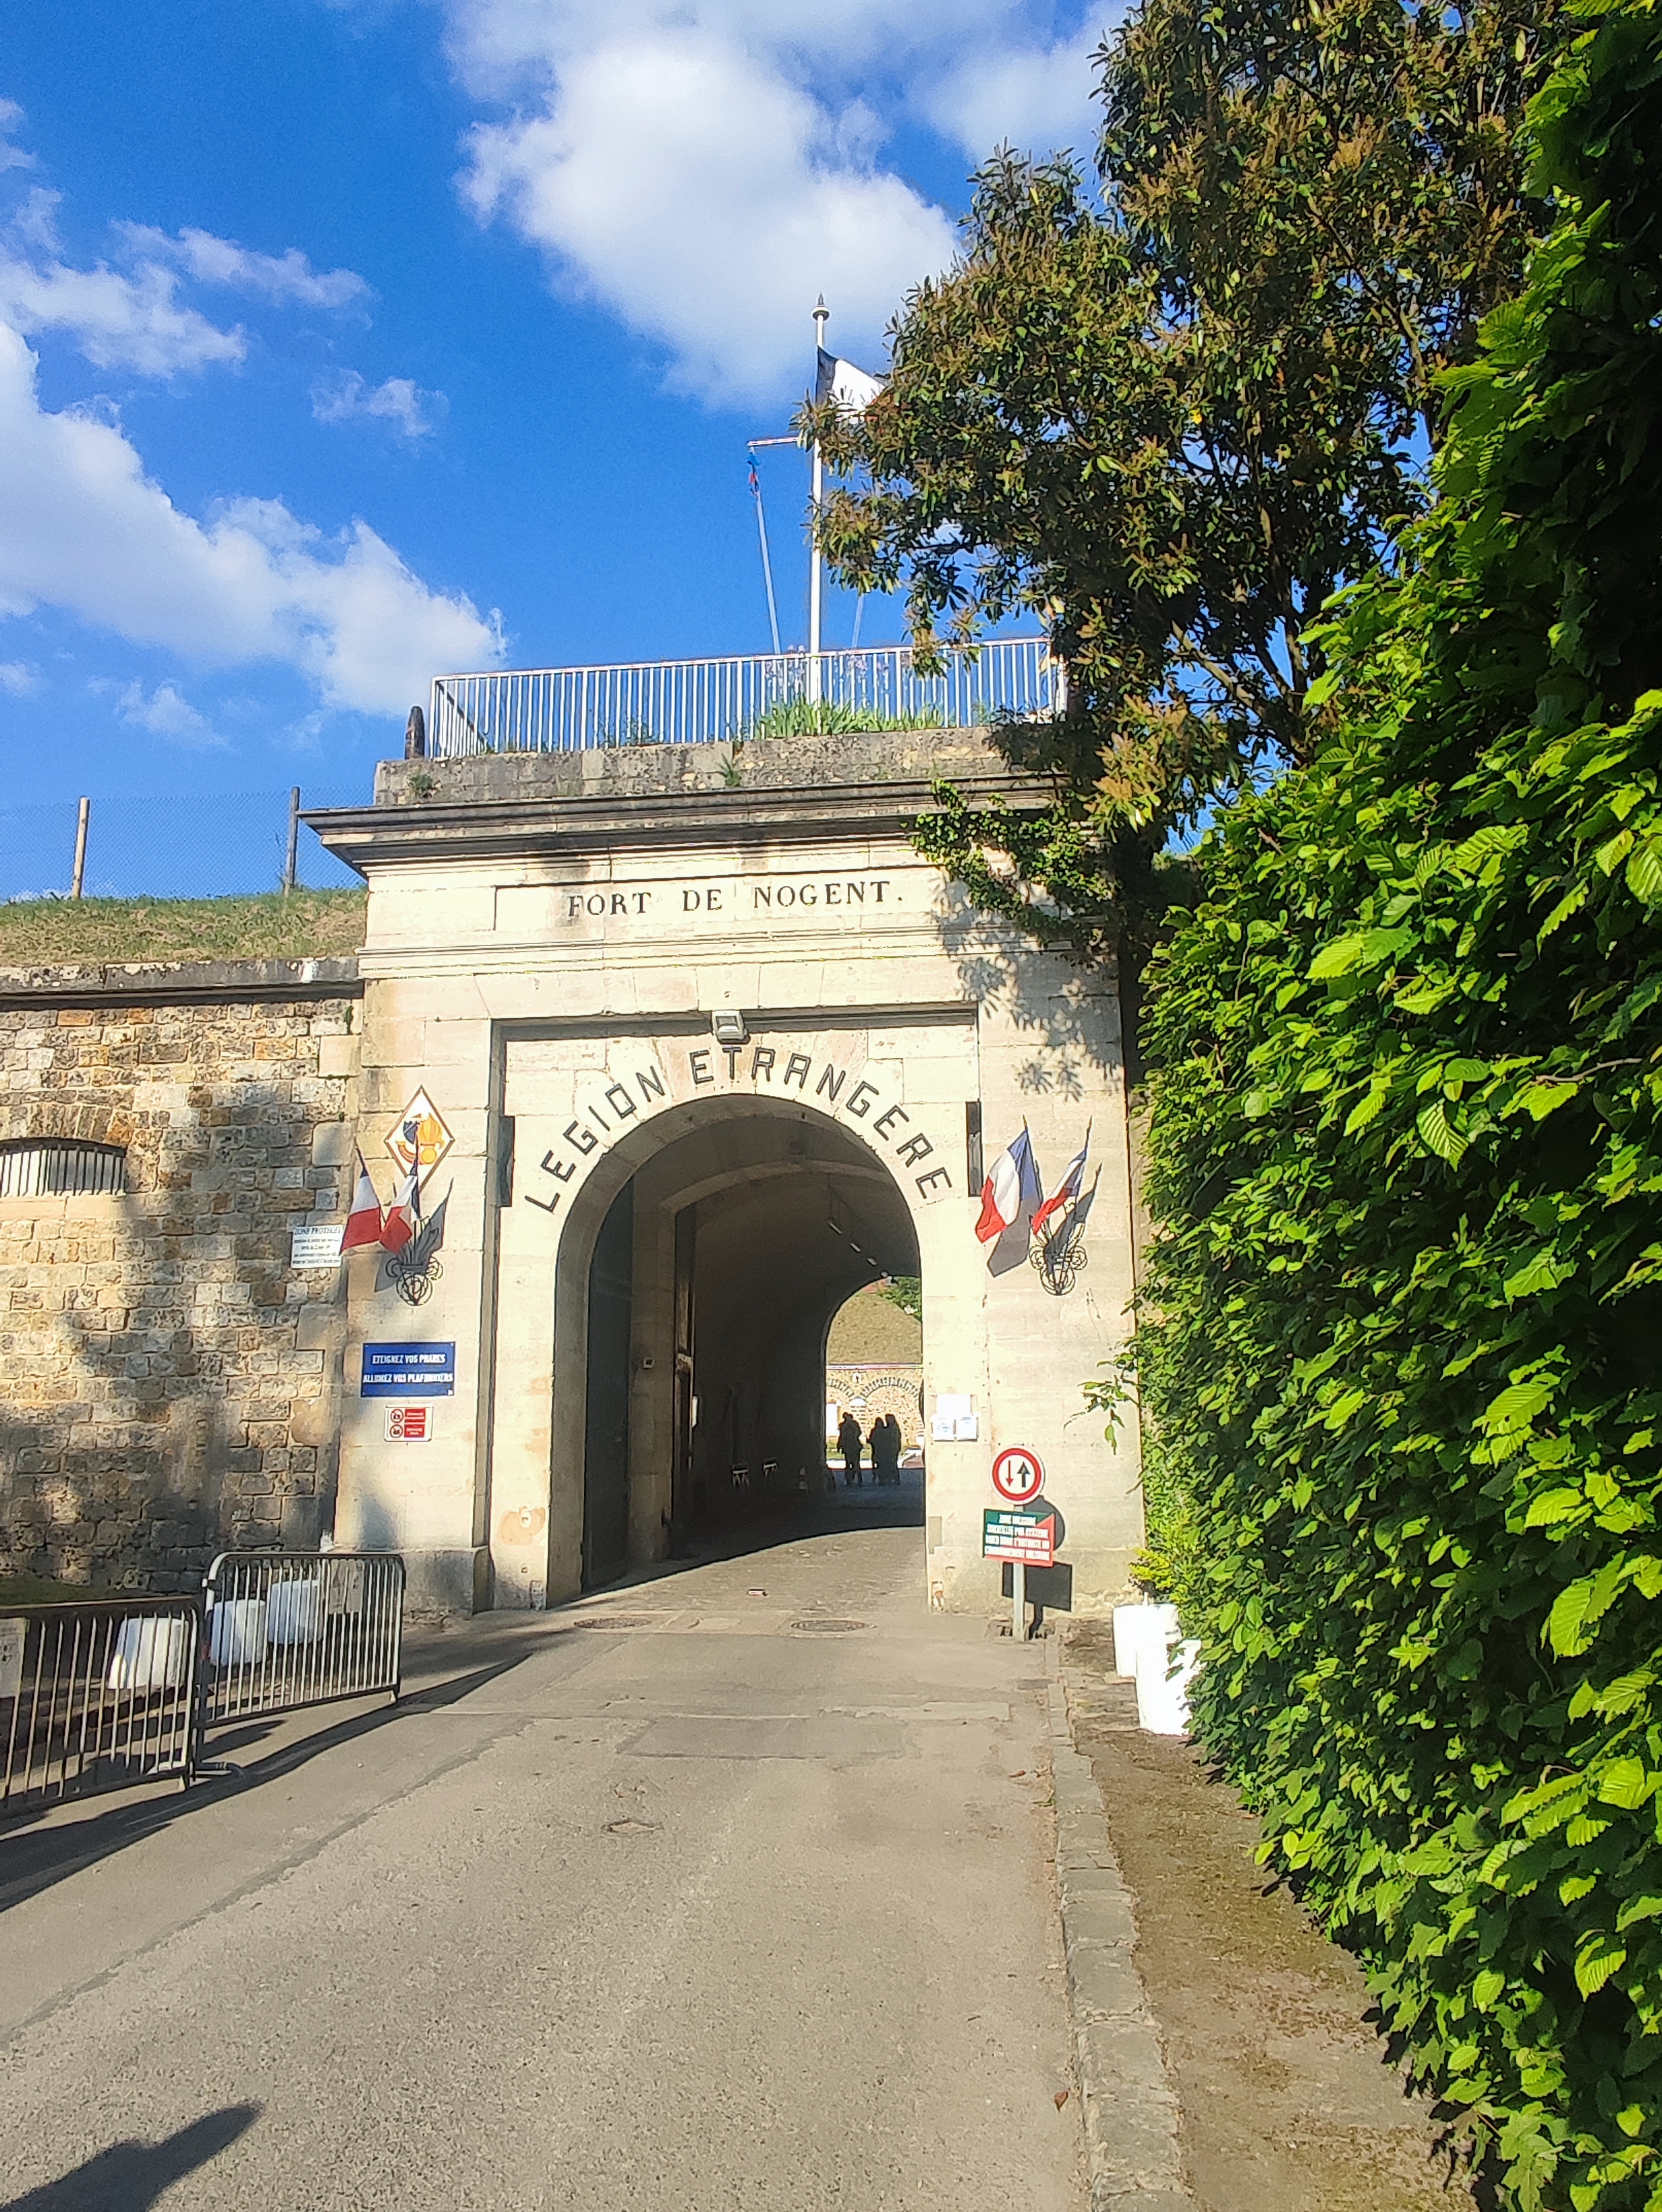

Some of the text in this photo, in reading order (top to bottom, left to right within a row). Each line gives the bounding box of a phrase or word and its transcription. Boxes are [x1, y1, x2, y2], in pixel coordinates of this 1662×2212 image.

[568, 881, 903, 917] FORT DE NOGENT.
[524, 1046, 952, 1213] LEGION ETRANGERE
